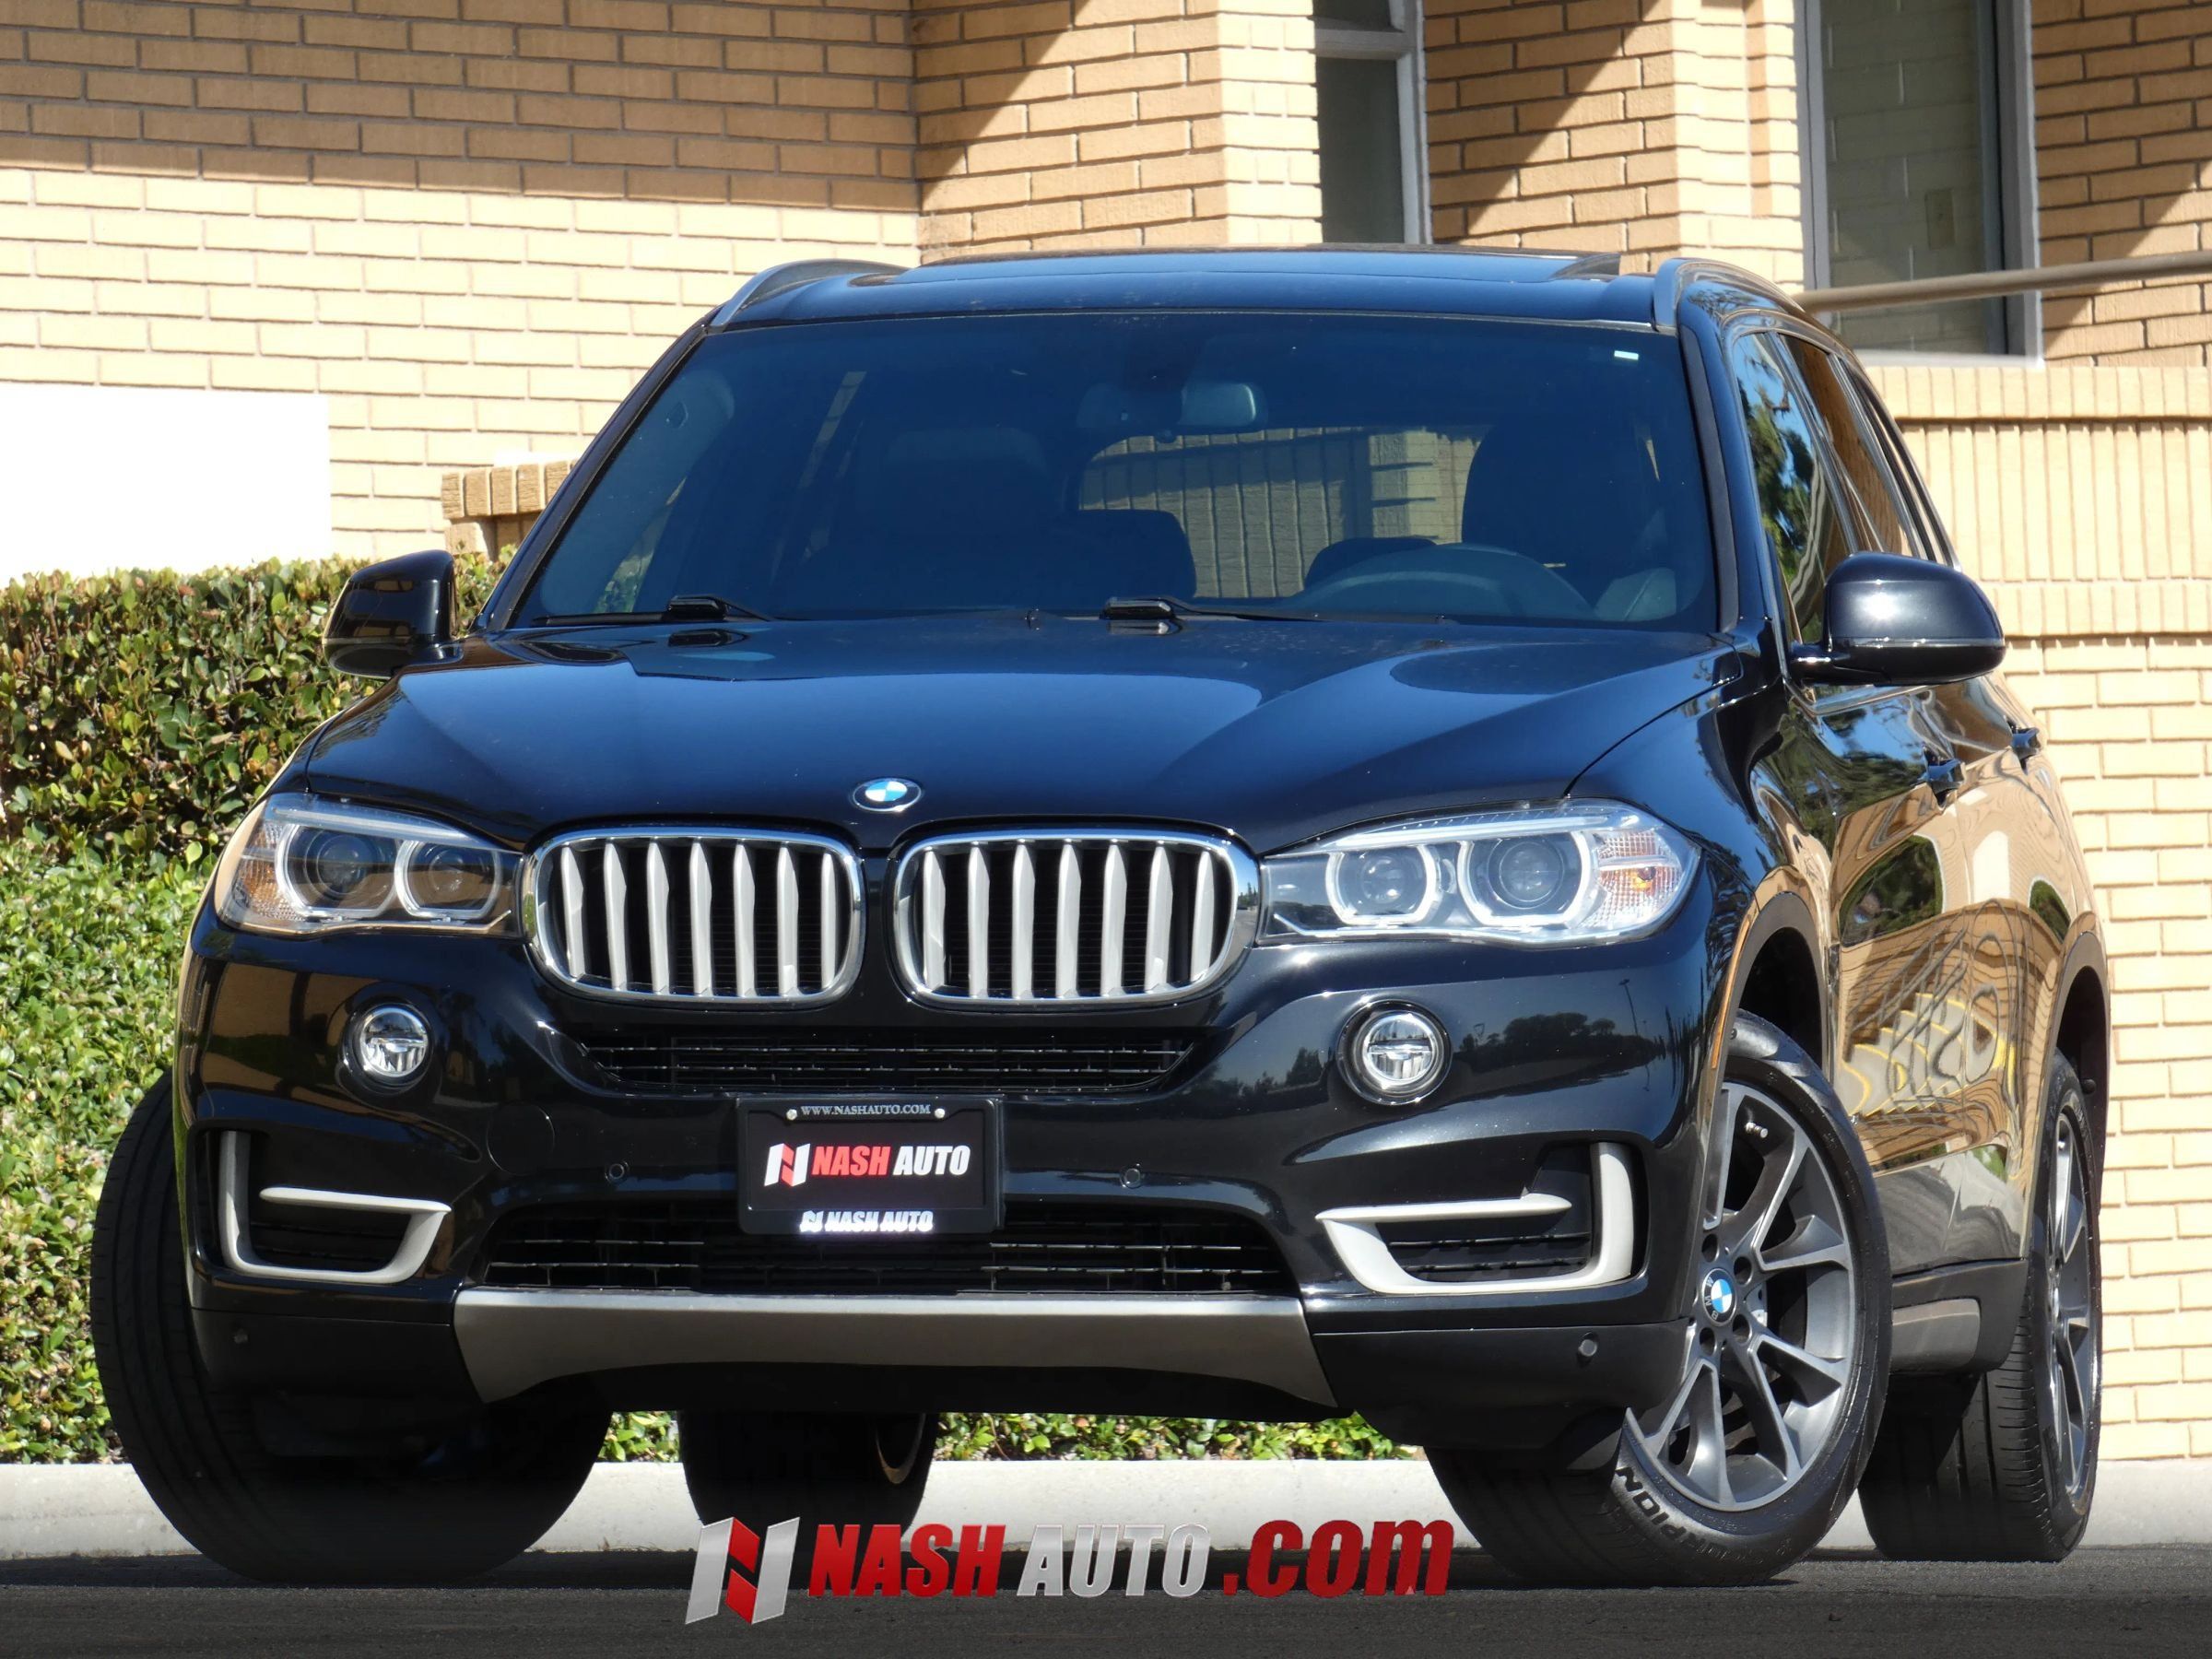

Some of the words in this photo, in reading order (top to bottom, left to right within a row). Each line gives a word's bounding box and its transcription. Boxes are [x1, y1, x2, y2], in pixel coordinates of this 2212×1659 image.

[800, 1104, 931, 1115] WWW.NASHAUTO.COM
[811, 1145, 891, 1176] NASH
[892, 1145, 971, 1176] AUTO
[824, 1210, 879, 1232] NASH
[879, 1210, 934, 1232] AUTO
